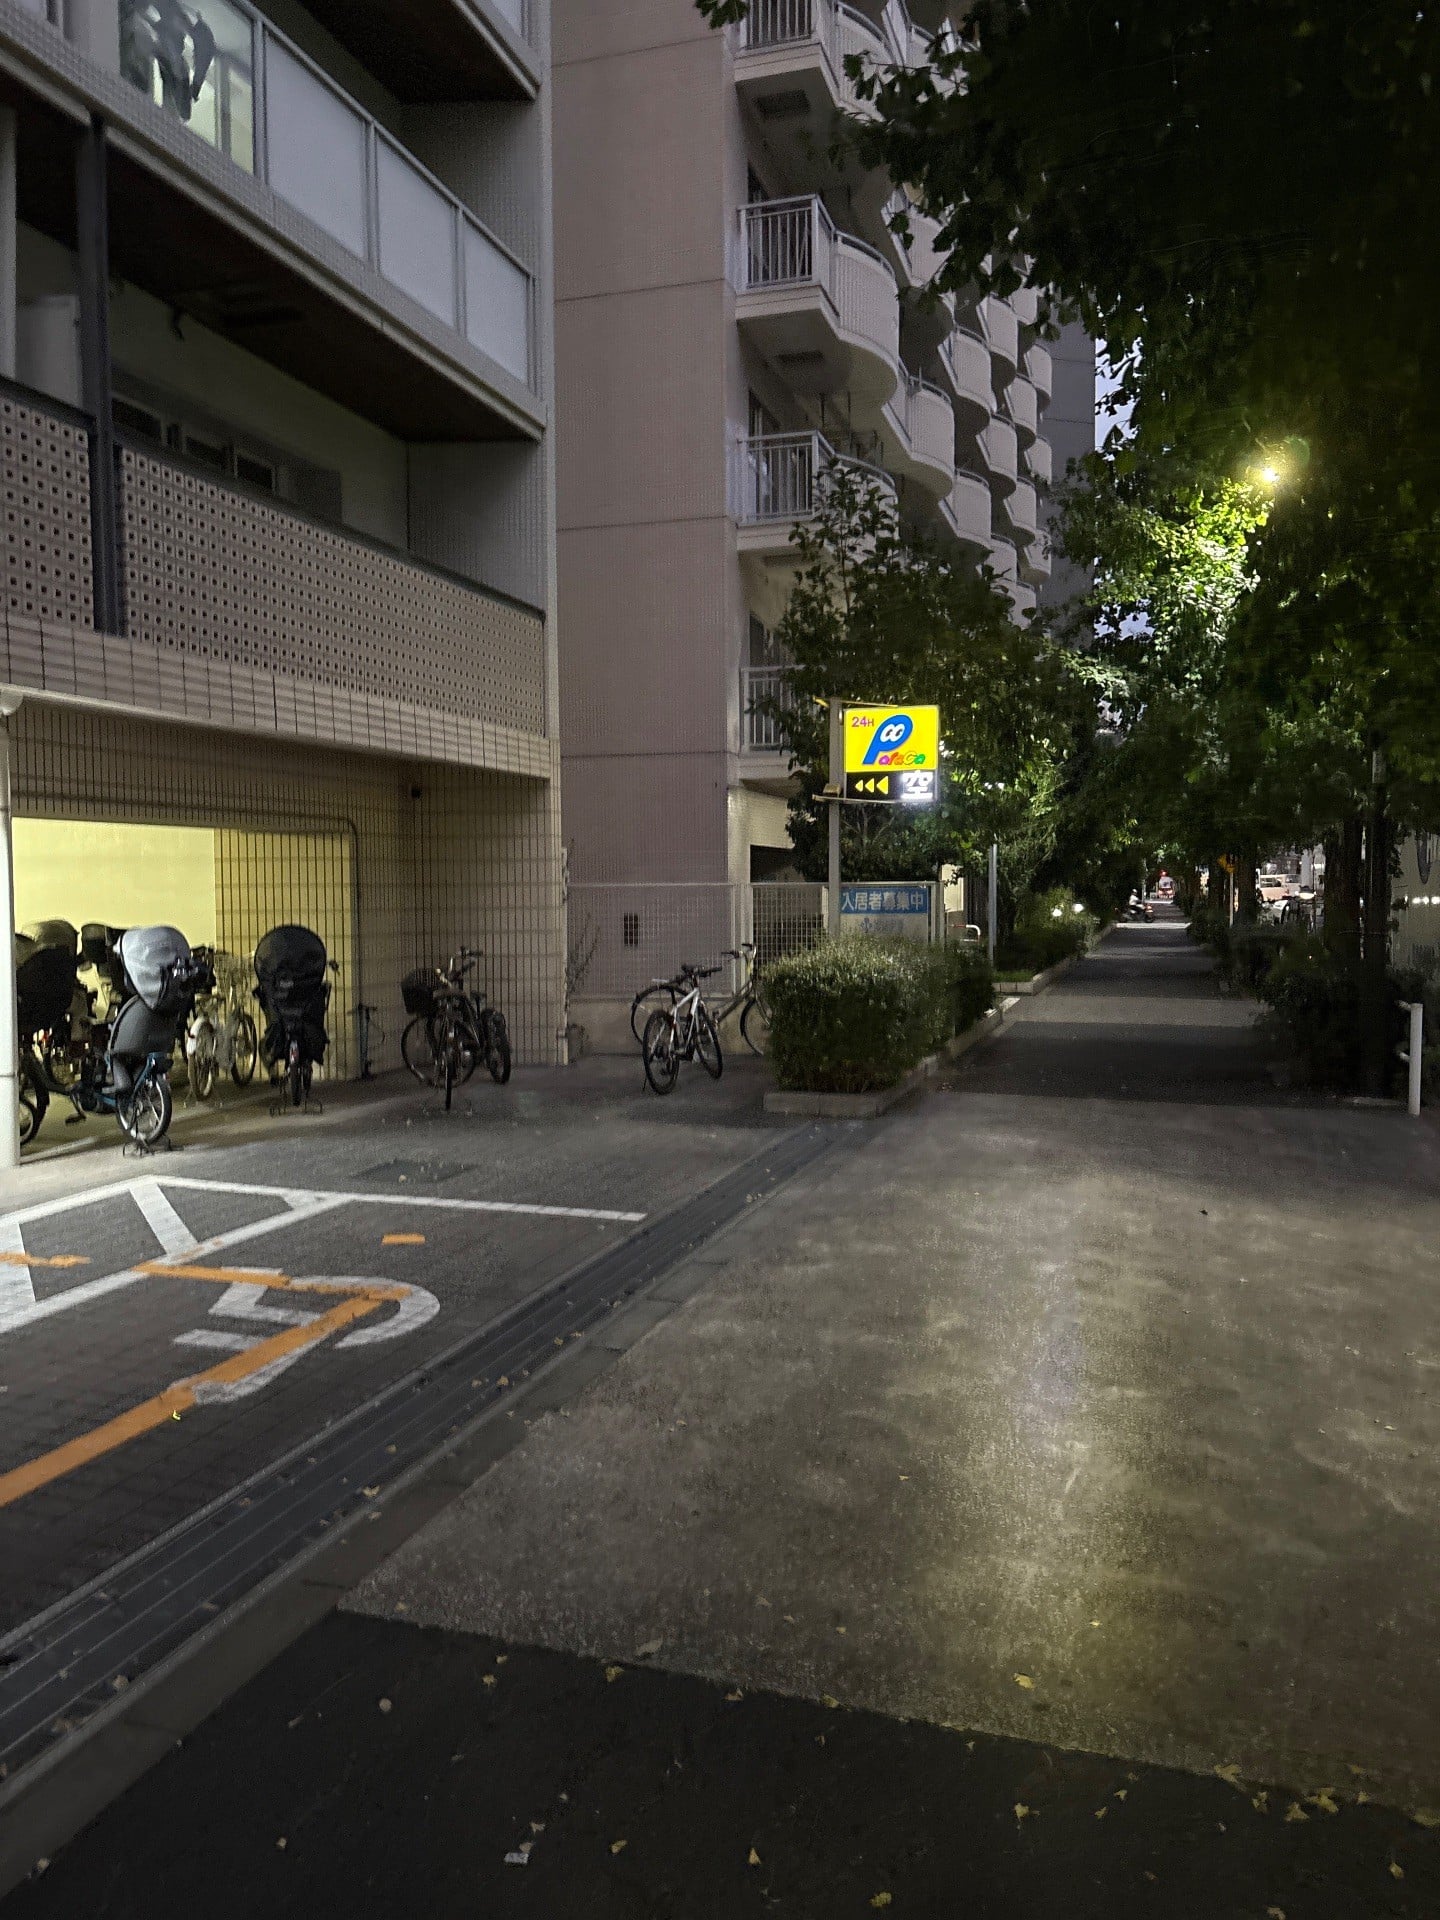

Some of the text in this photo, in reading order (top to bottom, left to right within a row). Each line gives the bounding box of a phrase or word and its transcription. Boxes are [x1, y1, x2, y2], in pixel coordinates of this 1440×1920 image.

[851, 716, 875, 728] 24H
[901, 769, 934, 800] 空
[841, 890, 924, 911] 入居者募集中
